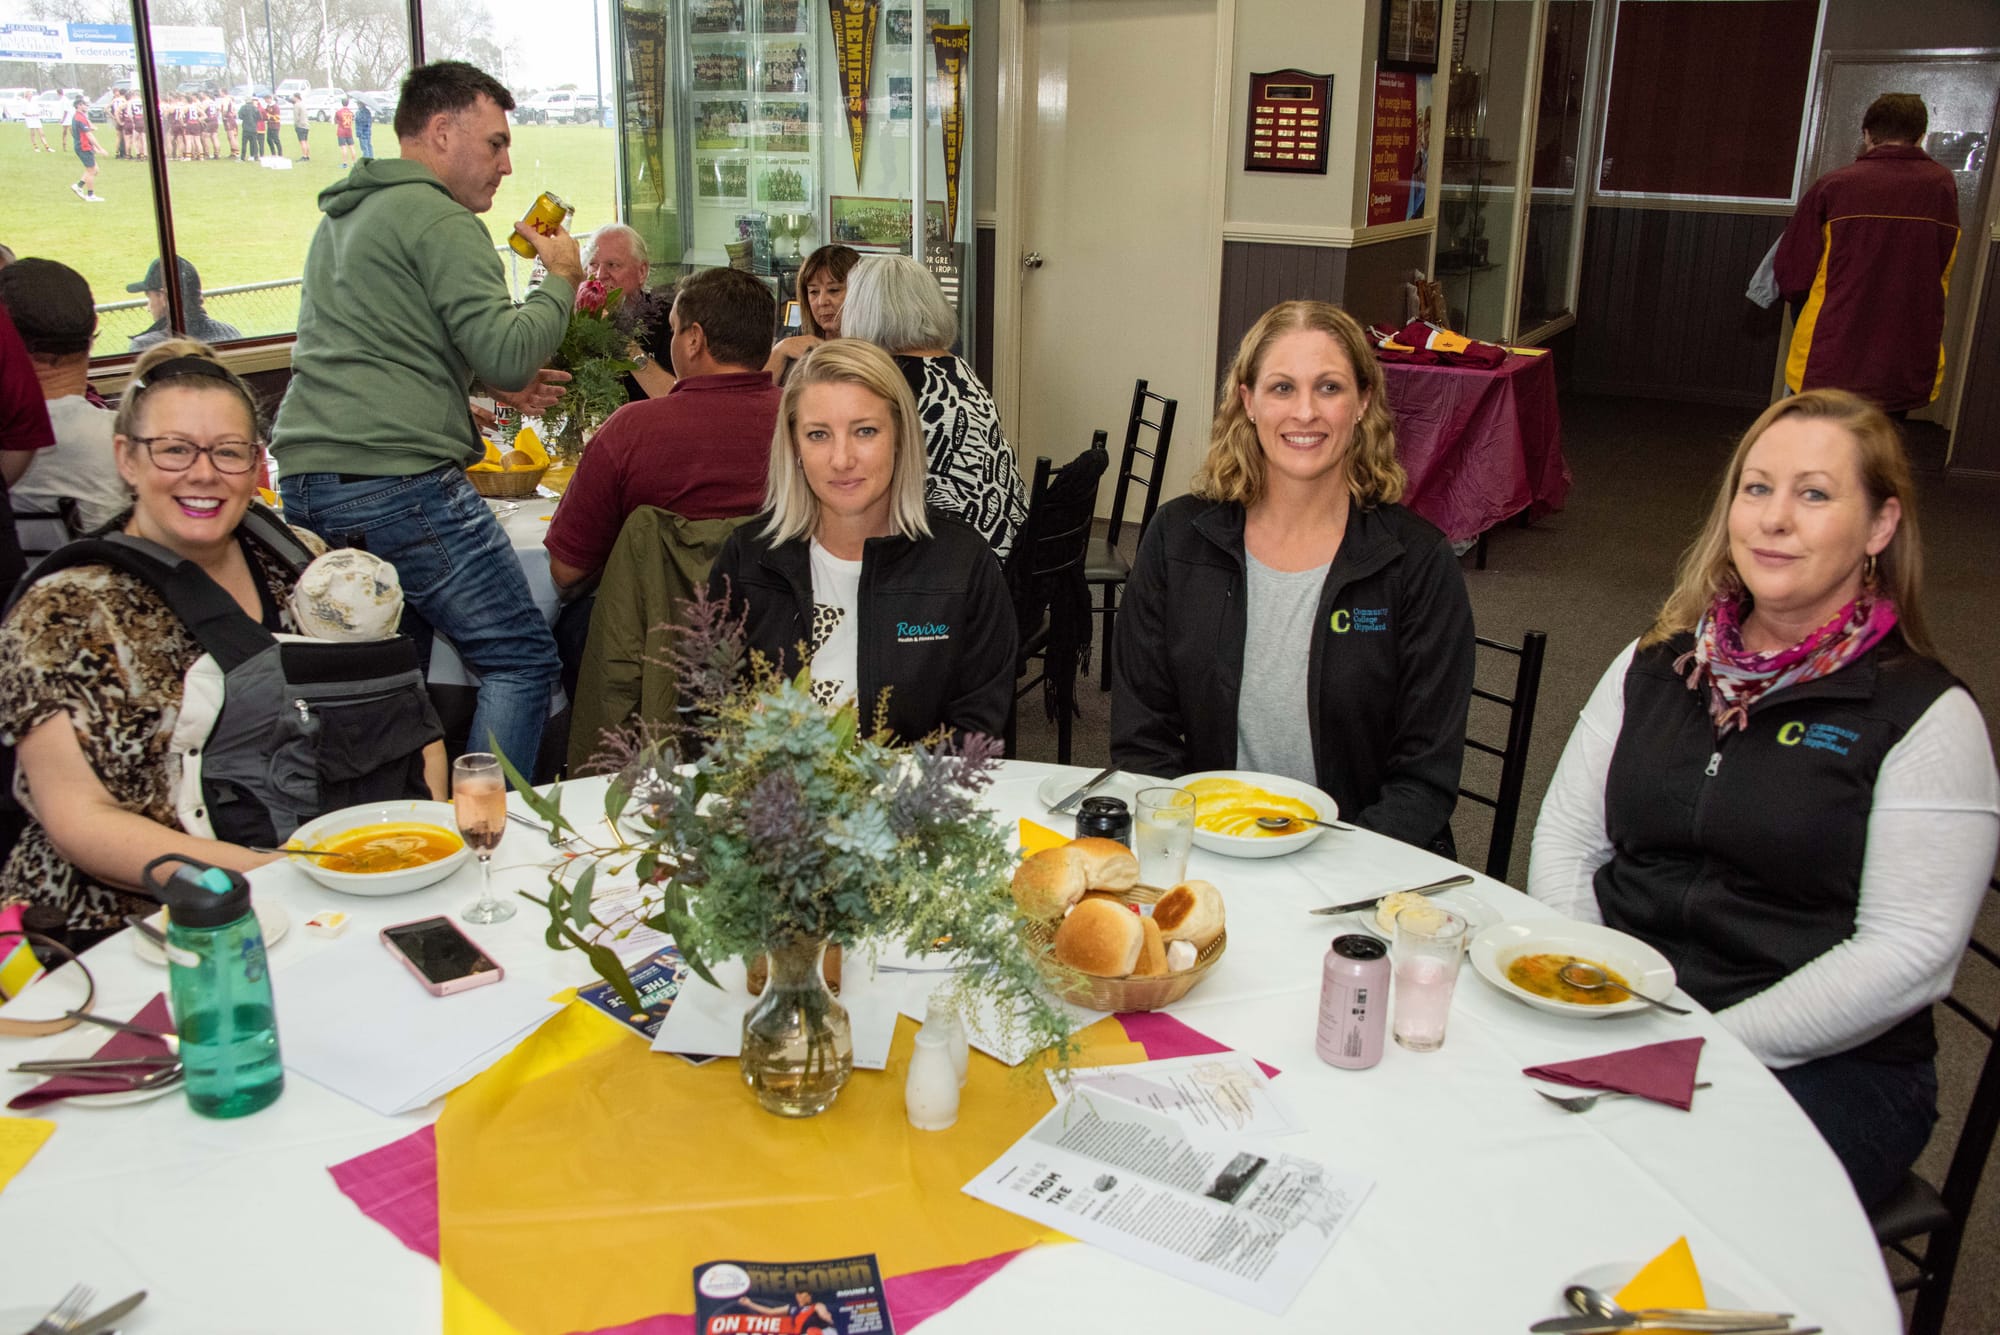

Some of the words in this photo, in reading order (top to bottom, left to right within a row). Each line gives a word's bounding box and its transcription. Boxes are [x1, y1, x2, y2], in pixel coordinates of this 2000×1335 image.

[832, 10, 845, 48] DROUIN
[75, 47, 128, 57] Federation
[844, 0, 865, 111] PREMIERS
[854, 132, 862, 153] 2010
[1331, 609, 1351, 633] C
[1353, 608, 1389, 616] Community
[1353, 615, 1378, 625] College
[896, 622, 950, 637] Revive
[1354, 622, 1387, 633] Gippsland
[1776, 721, 1805, 746] C
[641, 977, 670, 994] THE
[639, 984, 679, 1009] EEPIN
[1029, 1172, 1062, 1199] FROM
[1046, 1186, 1072, 1205] THE
[747, 1264, 873, 1292] RECORD
[712, 1316, 740, 1334] ON
[746, 1317, 781, 1333] THE
